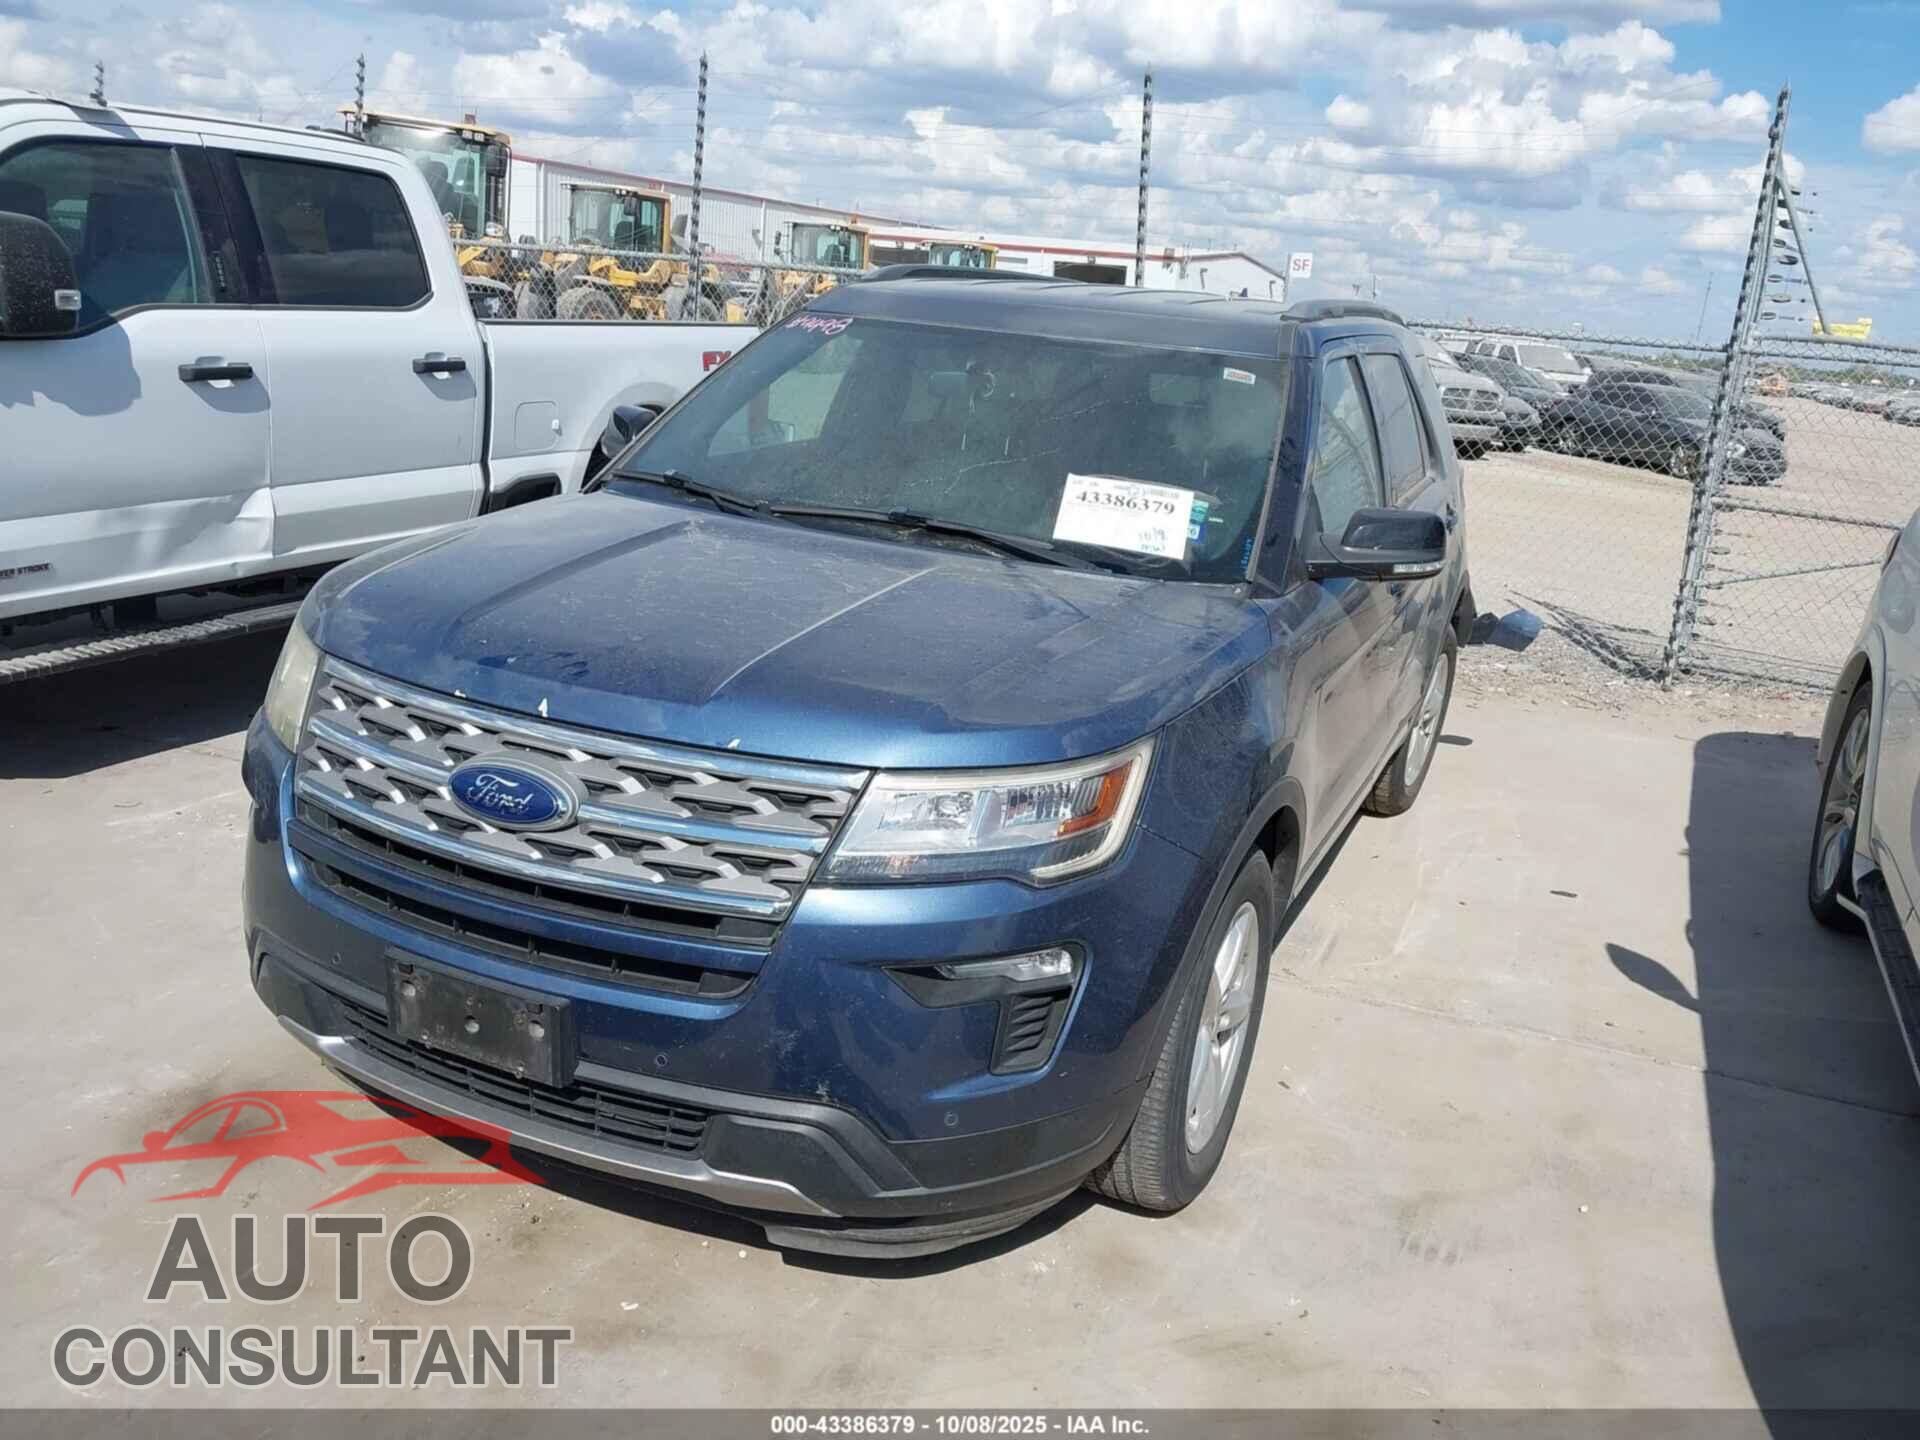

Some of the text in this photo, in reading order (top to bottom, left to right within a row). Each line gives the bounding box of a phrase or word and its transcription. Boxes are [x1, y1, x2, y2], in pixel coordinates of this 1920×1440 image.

[1292, 257, 1310, 271] SF
[1076, 489, 1175, 514] 43386379
[465, 774, 534, 816] Ford
